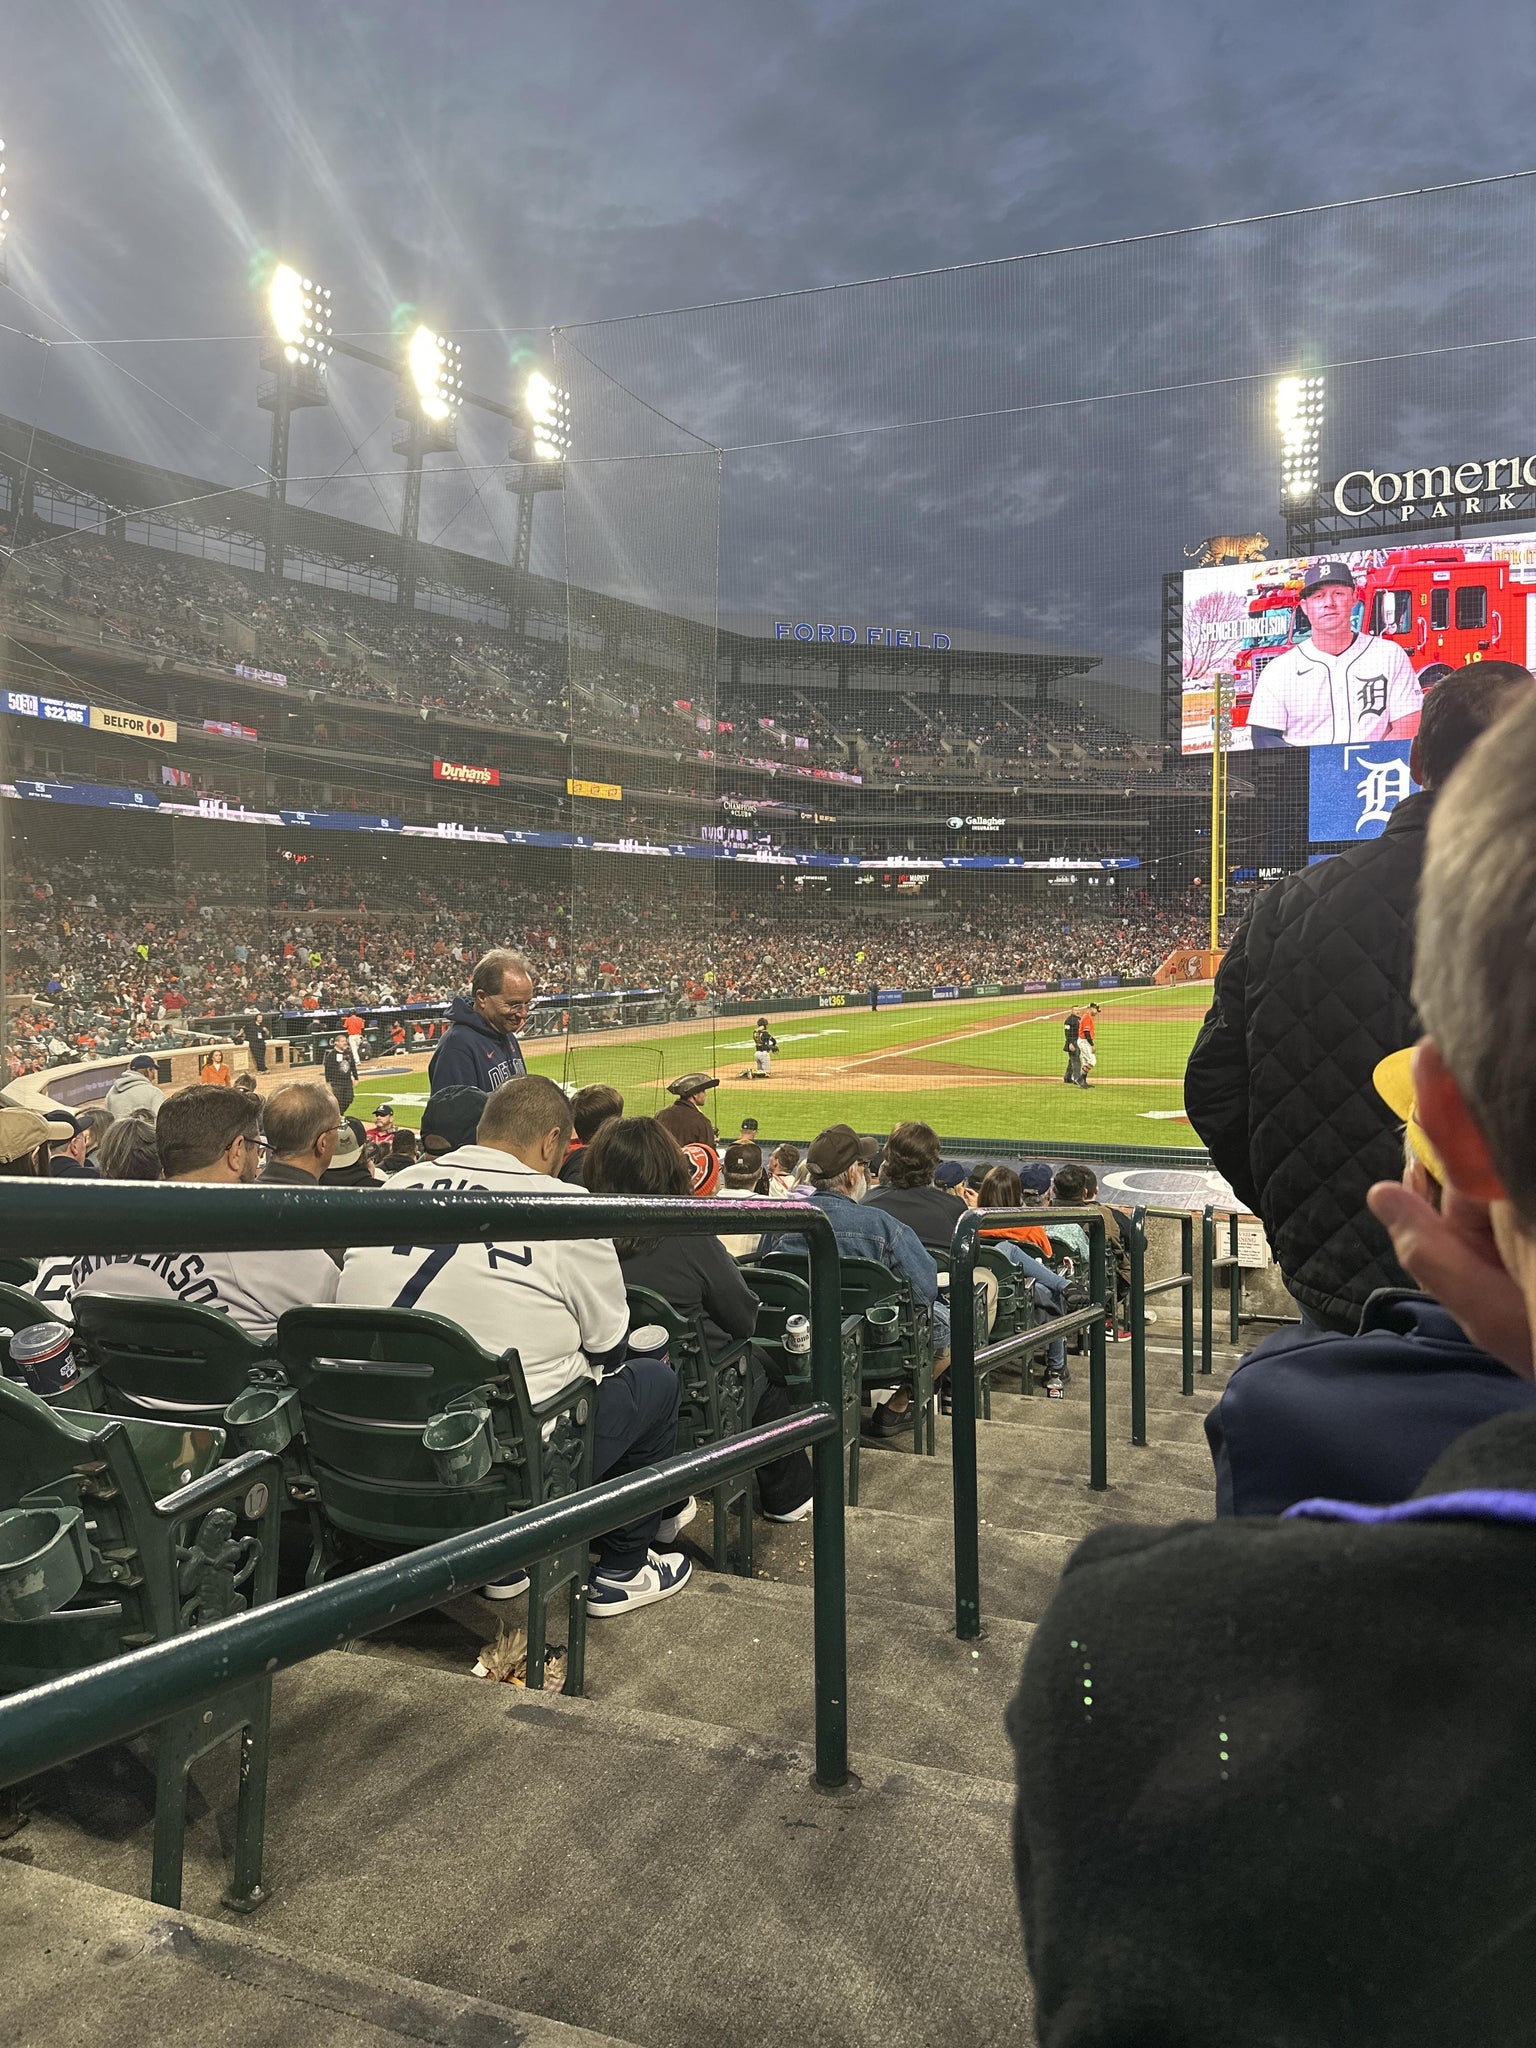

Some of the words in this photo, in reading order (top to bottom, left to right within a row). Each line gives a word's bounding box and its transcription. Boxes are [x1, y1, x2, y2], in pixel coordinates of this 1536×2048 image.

[1400, 493, 1517, 523] PARK
[774, 621, 857, 645] FORD
[866, 626, 952, 651] FIELD
[1200, 620, 1238, 643] SPENCER
[1240, 614, 1287, 638] TORKELSON
[1355, 673, 1389, 723] D
[44, 705, 84, 722] $22,185
[103, 713, 144, 732] BELFOR
[440, 762, 492, 781] Dunham's
[723, 800, 758, 814] CHAMPIONS
[965, 815, 1006, 827] Gallagher
[819, 995, 845, 1007] bet365
[248, 1486, 266, 1513] 17
